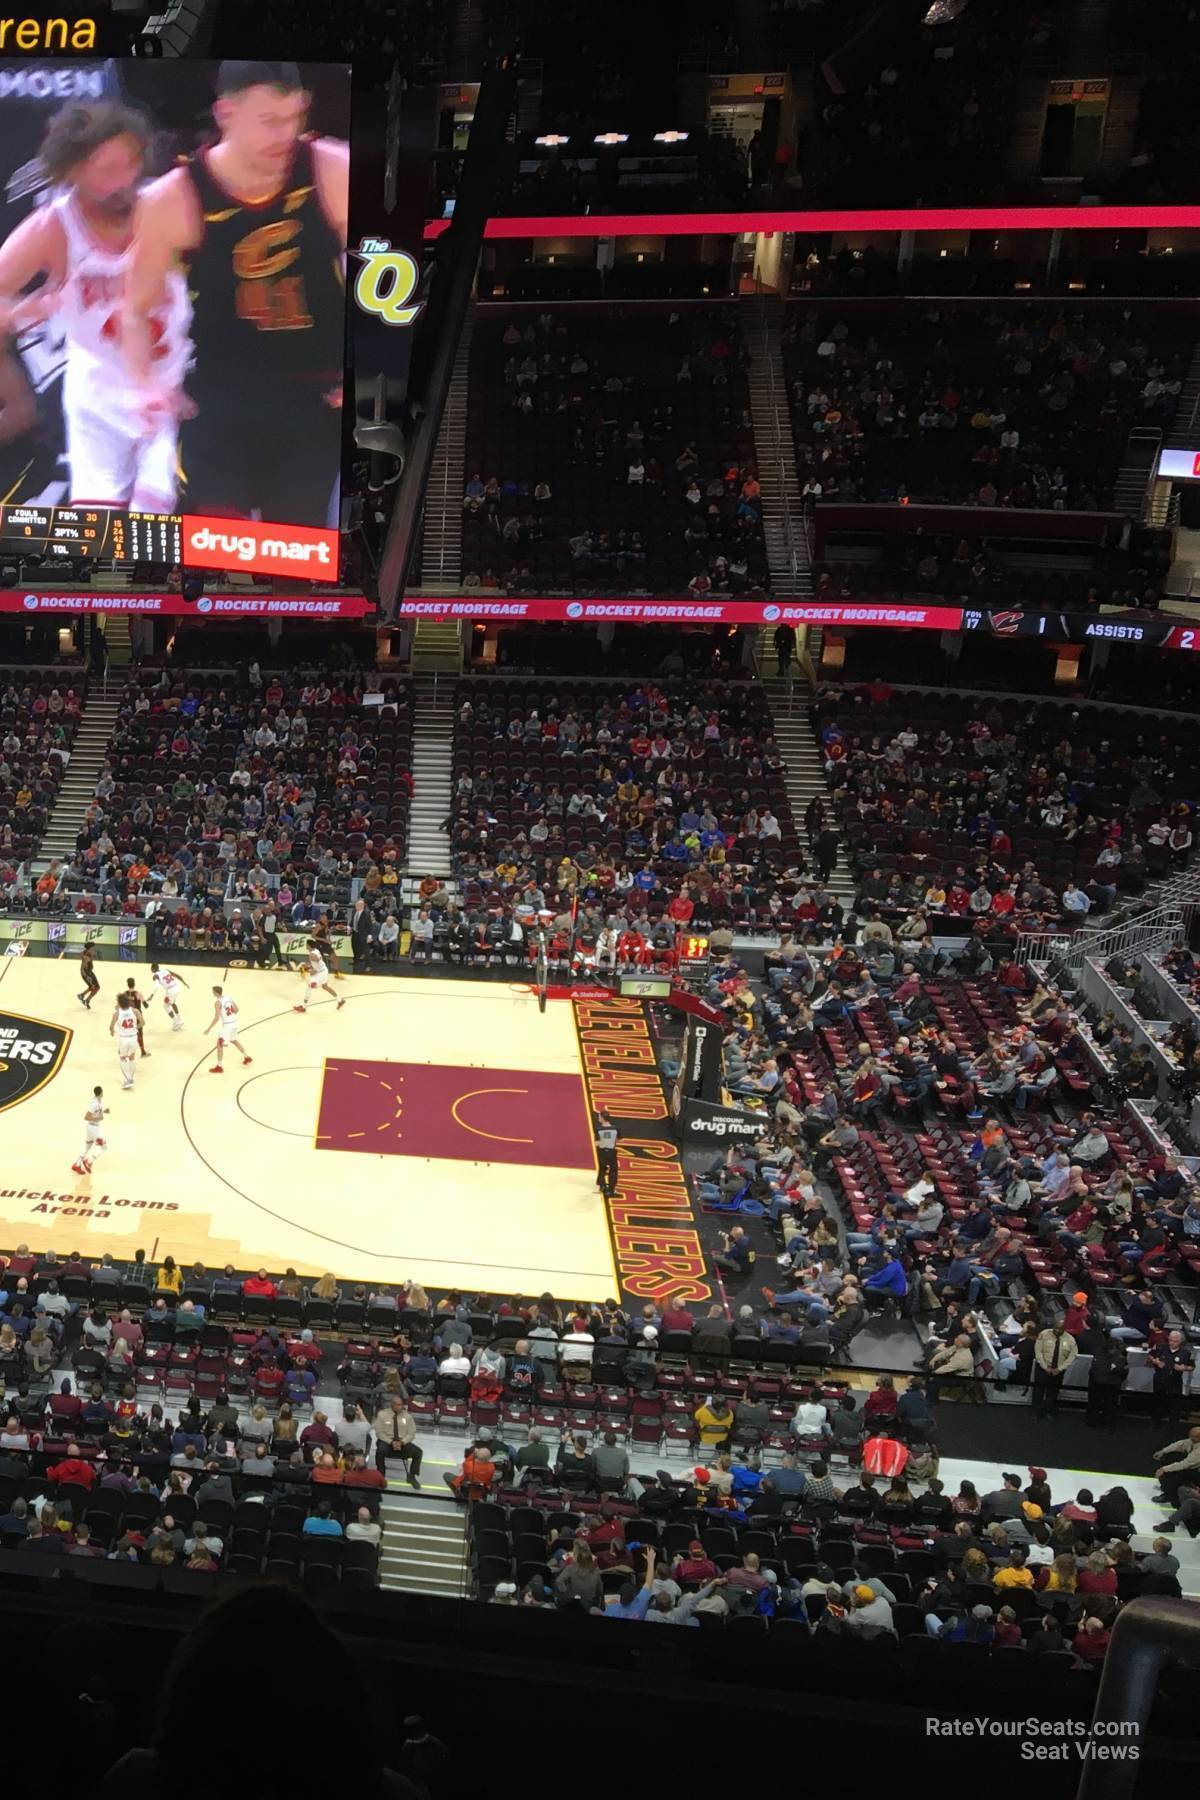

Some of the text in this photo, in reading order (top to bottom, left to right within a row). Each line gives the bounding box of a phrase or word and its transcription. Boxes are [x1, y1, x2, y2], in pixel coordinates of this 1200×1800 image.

[362, 239, 389, 252] The
[357, 252, 422, 324] Q
[8, 516, 46, 524] COMMITTED
[58, 512, 98, 522] FG% 30
[24, 526, 32, 536] 0
[54, 528, 96, 538] 3PT% 50
[53, 545, 88, 556] TOL 7
[191, 528, 331, 564] drug mart
[40, 597, 162, 609] ROCKET MORTGAGE
[214, 600, 341, 612] ROCKET MORTGAGE
[451, 604, 528, 615] MORTGAGE
[585, 604, 724, 617] ROCKET MORTGAGE
[782, 608, 927, 622] ROCKET MORTGAGE
[966, 618, 979, 629] 17
[1039, 617, 1046, 634] 1
[1085, 624, 1144, 640] ASSISTS
[1180, 631, 1195, 648] 2
[14, 921, 32, 938] ICE
[48, 923, 66, 940] ICE
[86, 925, 104, 942] ICE
[120, 927, 138, 944] ICE
[287, 936, 306, 952] ICE
[122, 1018, 134, 1030] 42
[692, 1038, 704, 1081] Cleveland Clinic
[690, 1118, 765, 1136] drug mart
[98, 1195, 180, 1210] Loans
[30, 1203, 112, 1218] Arena
